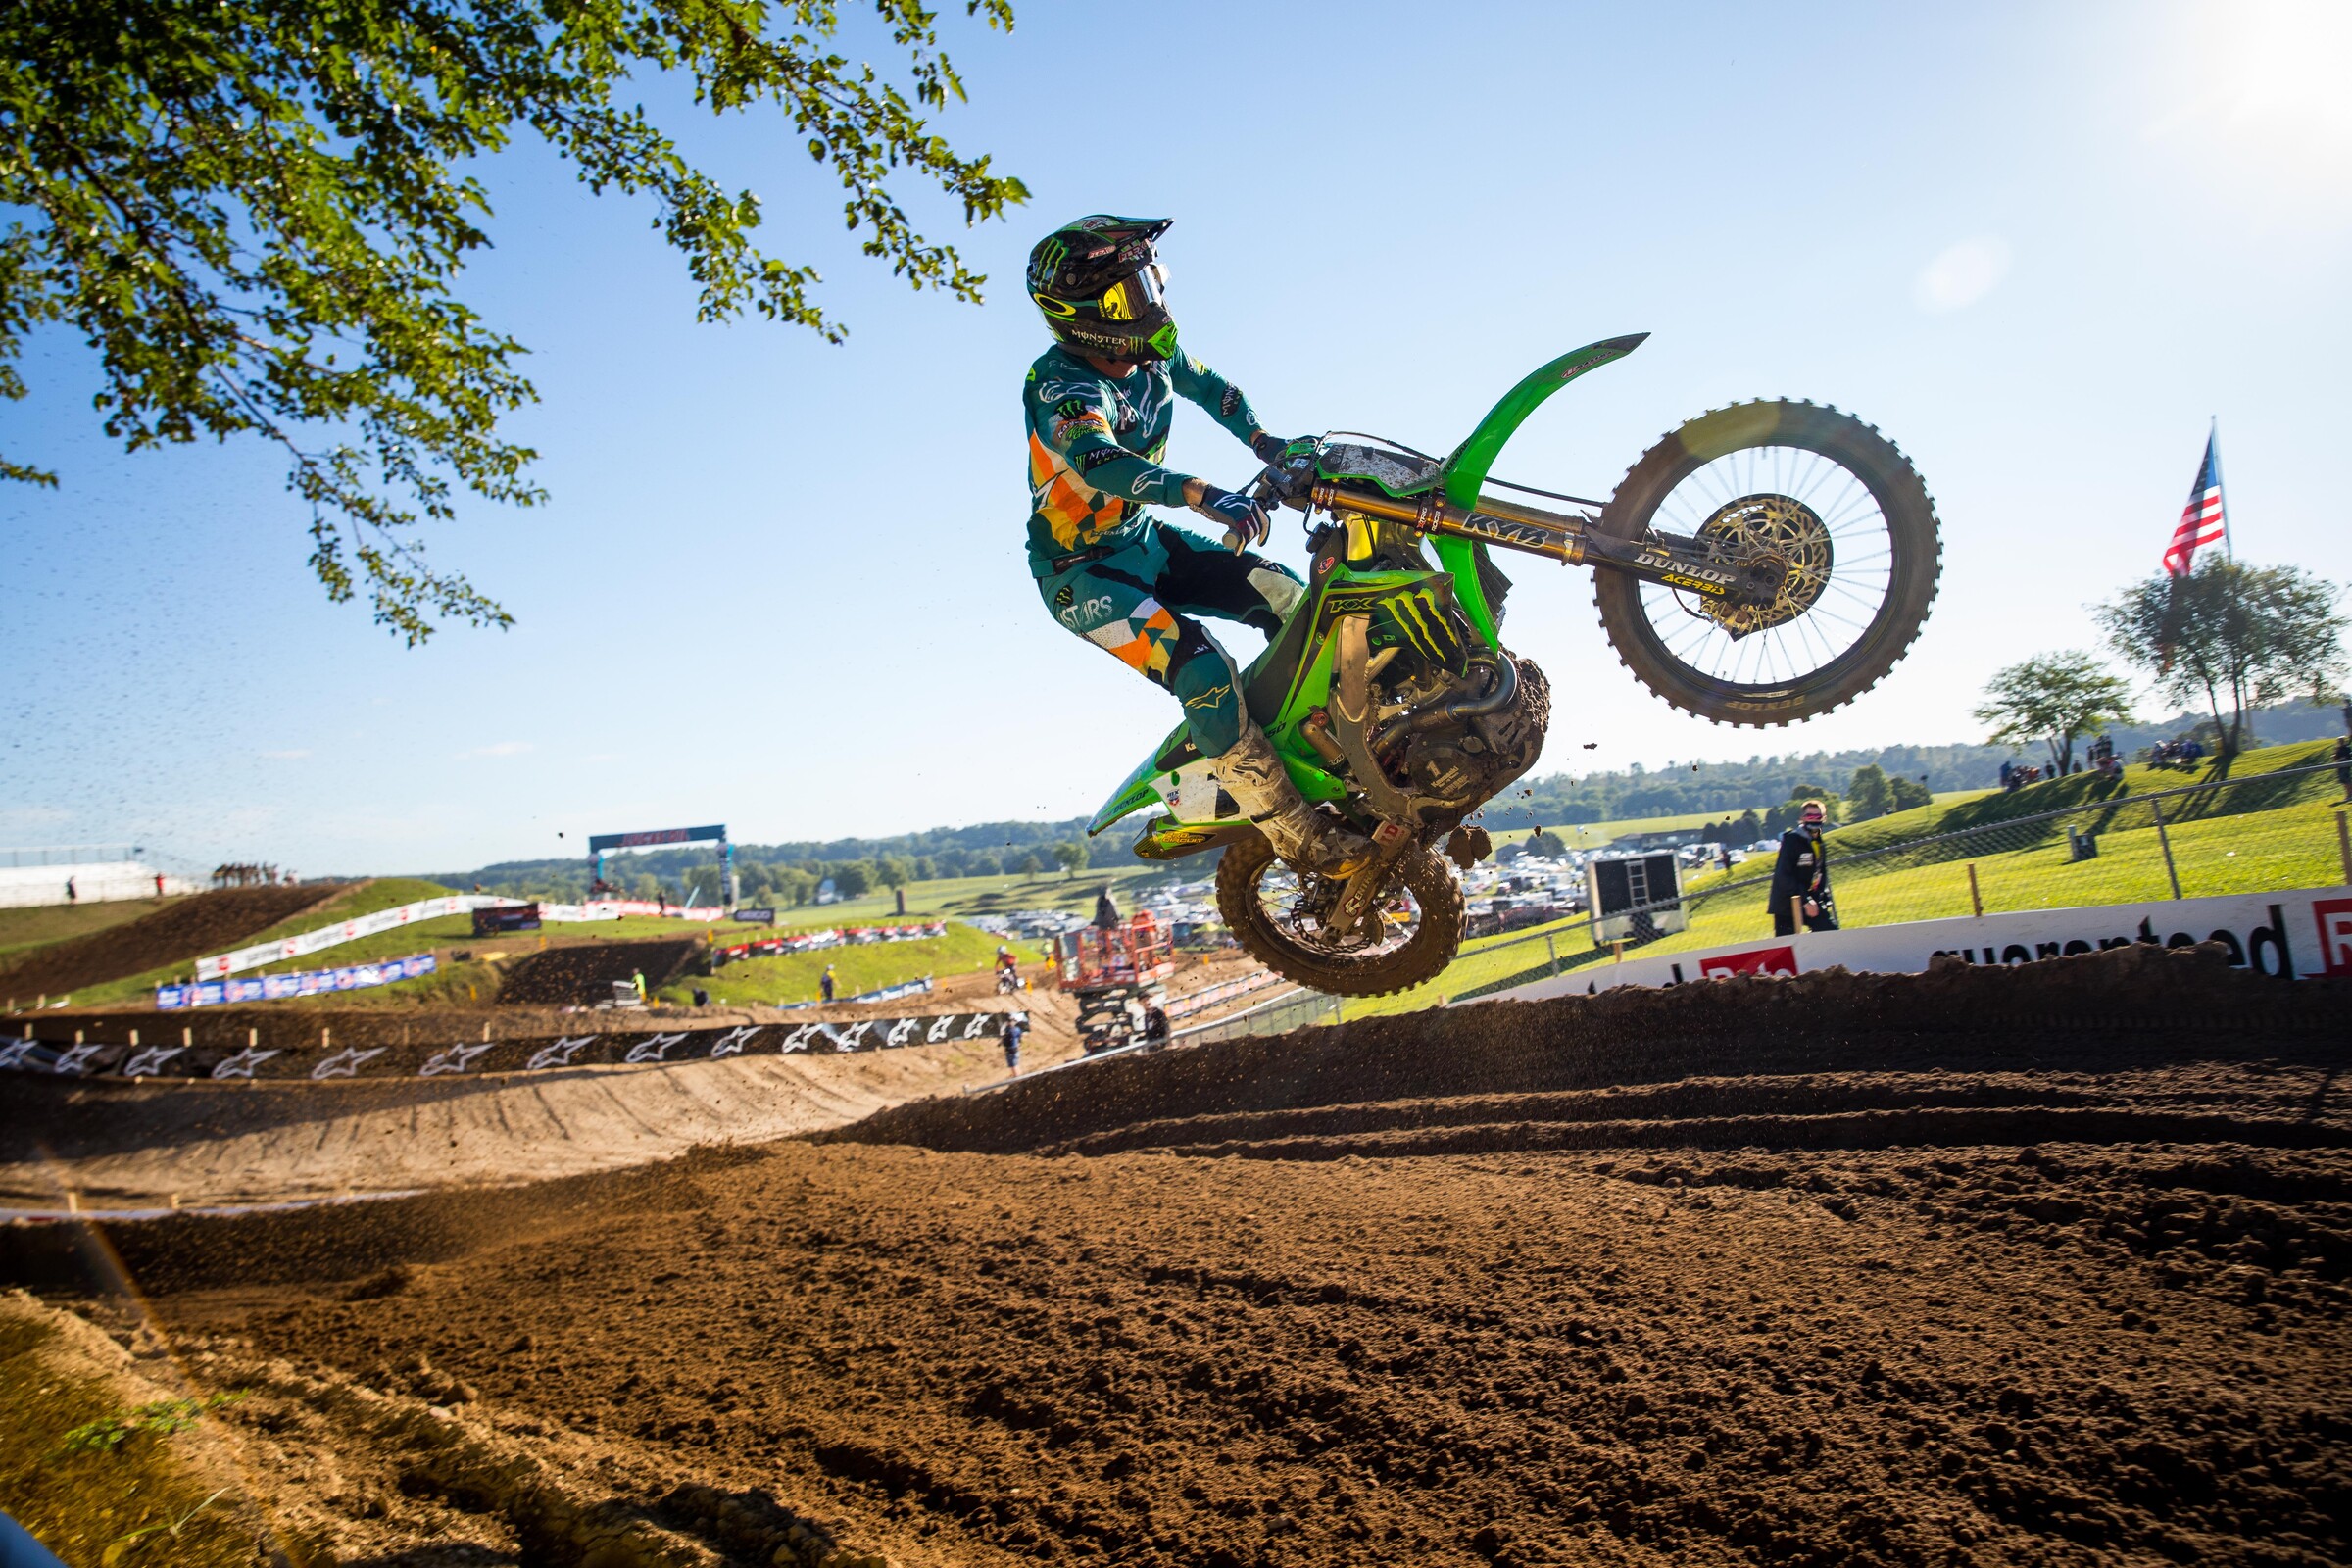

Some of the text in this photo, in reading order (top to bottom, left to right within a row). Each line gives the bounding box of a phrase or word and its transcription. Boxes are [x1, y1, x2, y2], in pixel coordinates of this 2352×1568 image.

[1071, 329, 1127, 346] MONSTER
[1443, 439, 1471, 475] TOMAC
[1431, 511, 1441, 532] ROCS
[1460, 513, 1550, 549] KYB
[1634, 552, 1737, 585] DUNLOP
[1327, 596, 1378, 613] KX
[1113, 788, 1149, 814] DUNLOP
